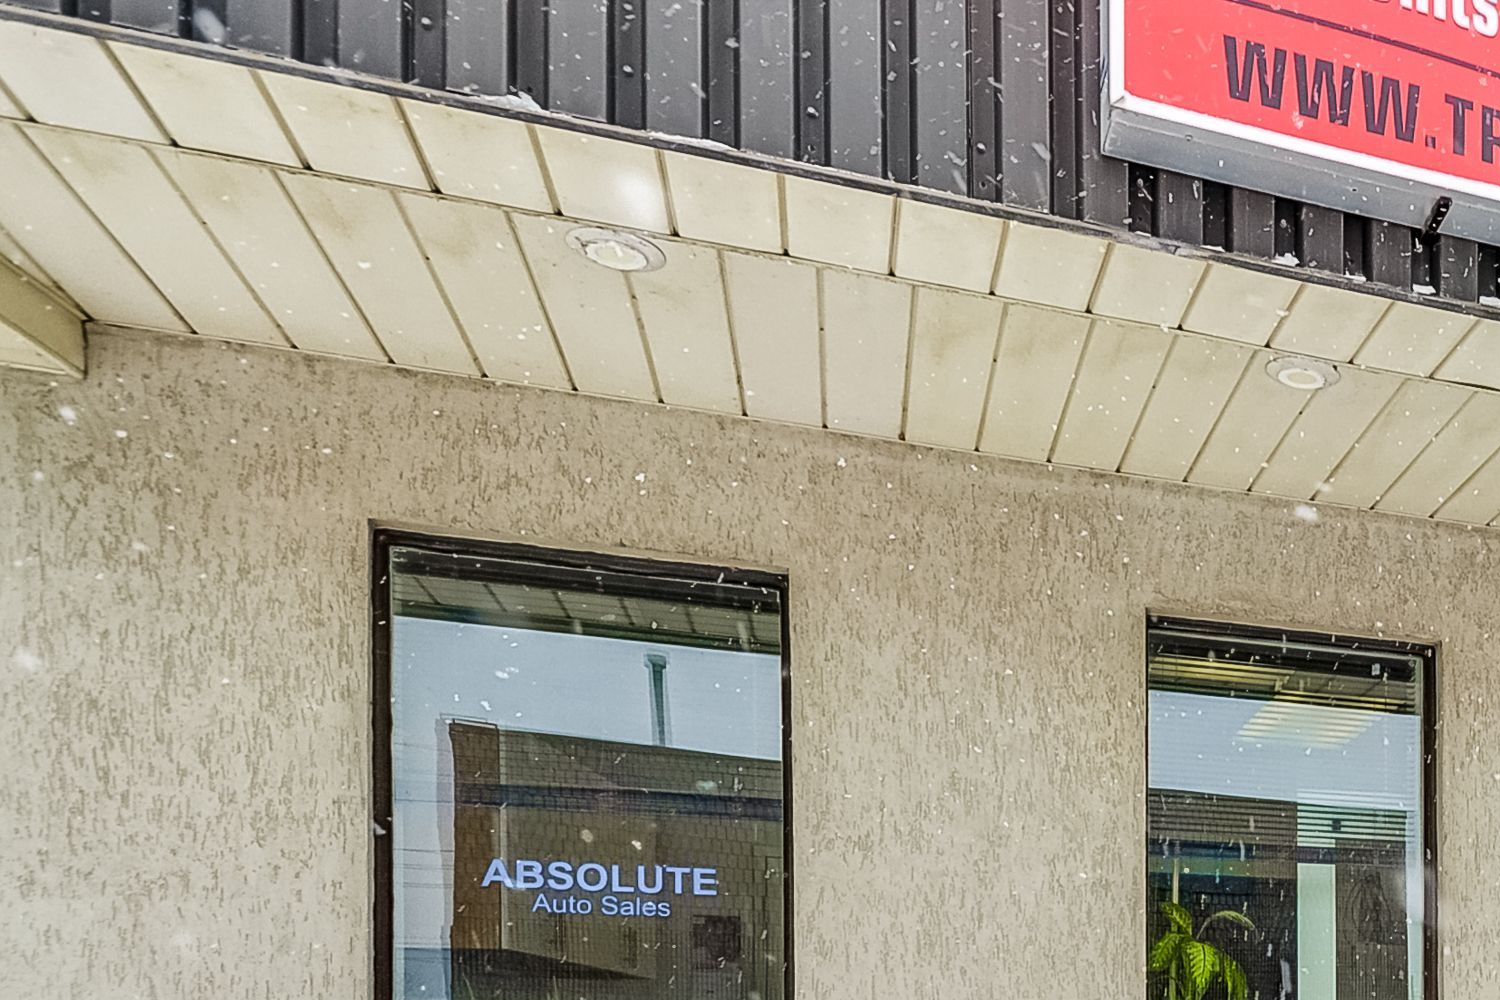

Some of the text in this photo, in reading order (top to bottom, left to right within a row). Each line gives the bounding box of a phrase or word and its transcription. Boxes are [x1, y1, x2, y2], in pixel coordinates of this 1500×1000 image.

[481, 858, 718, 897] ABSOLUTE
[532, 893, 672, 918] Auto Sales
